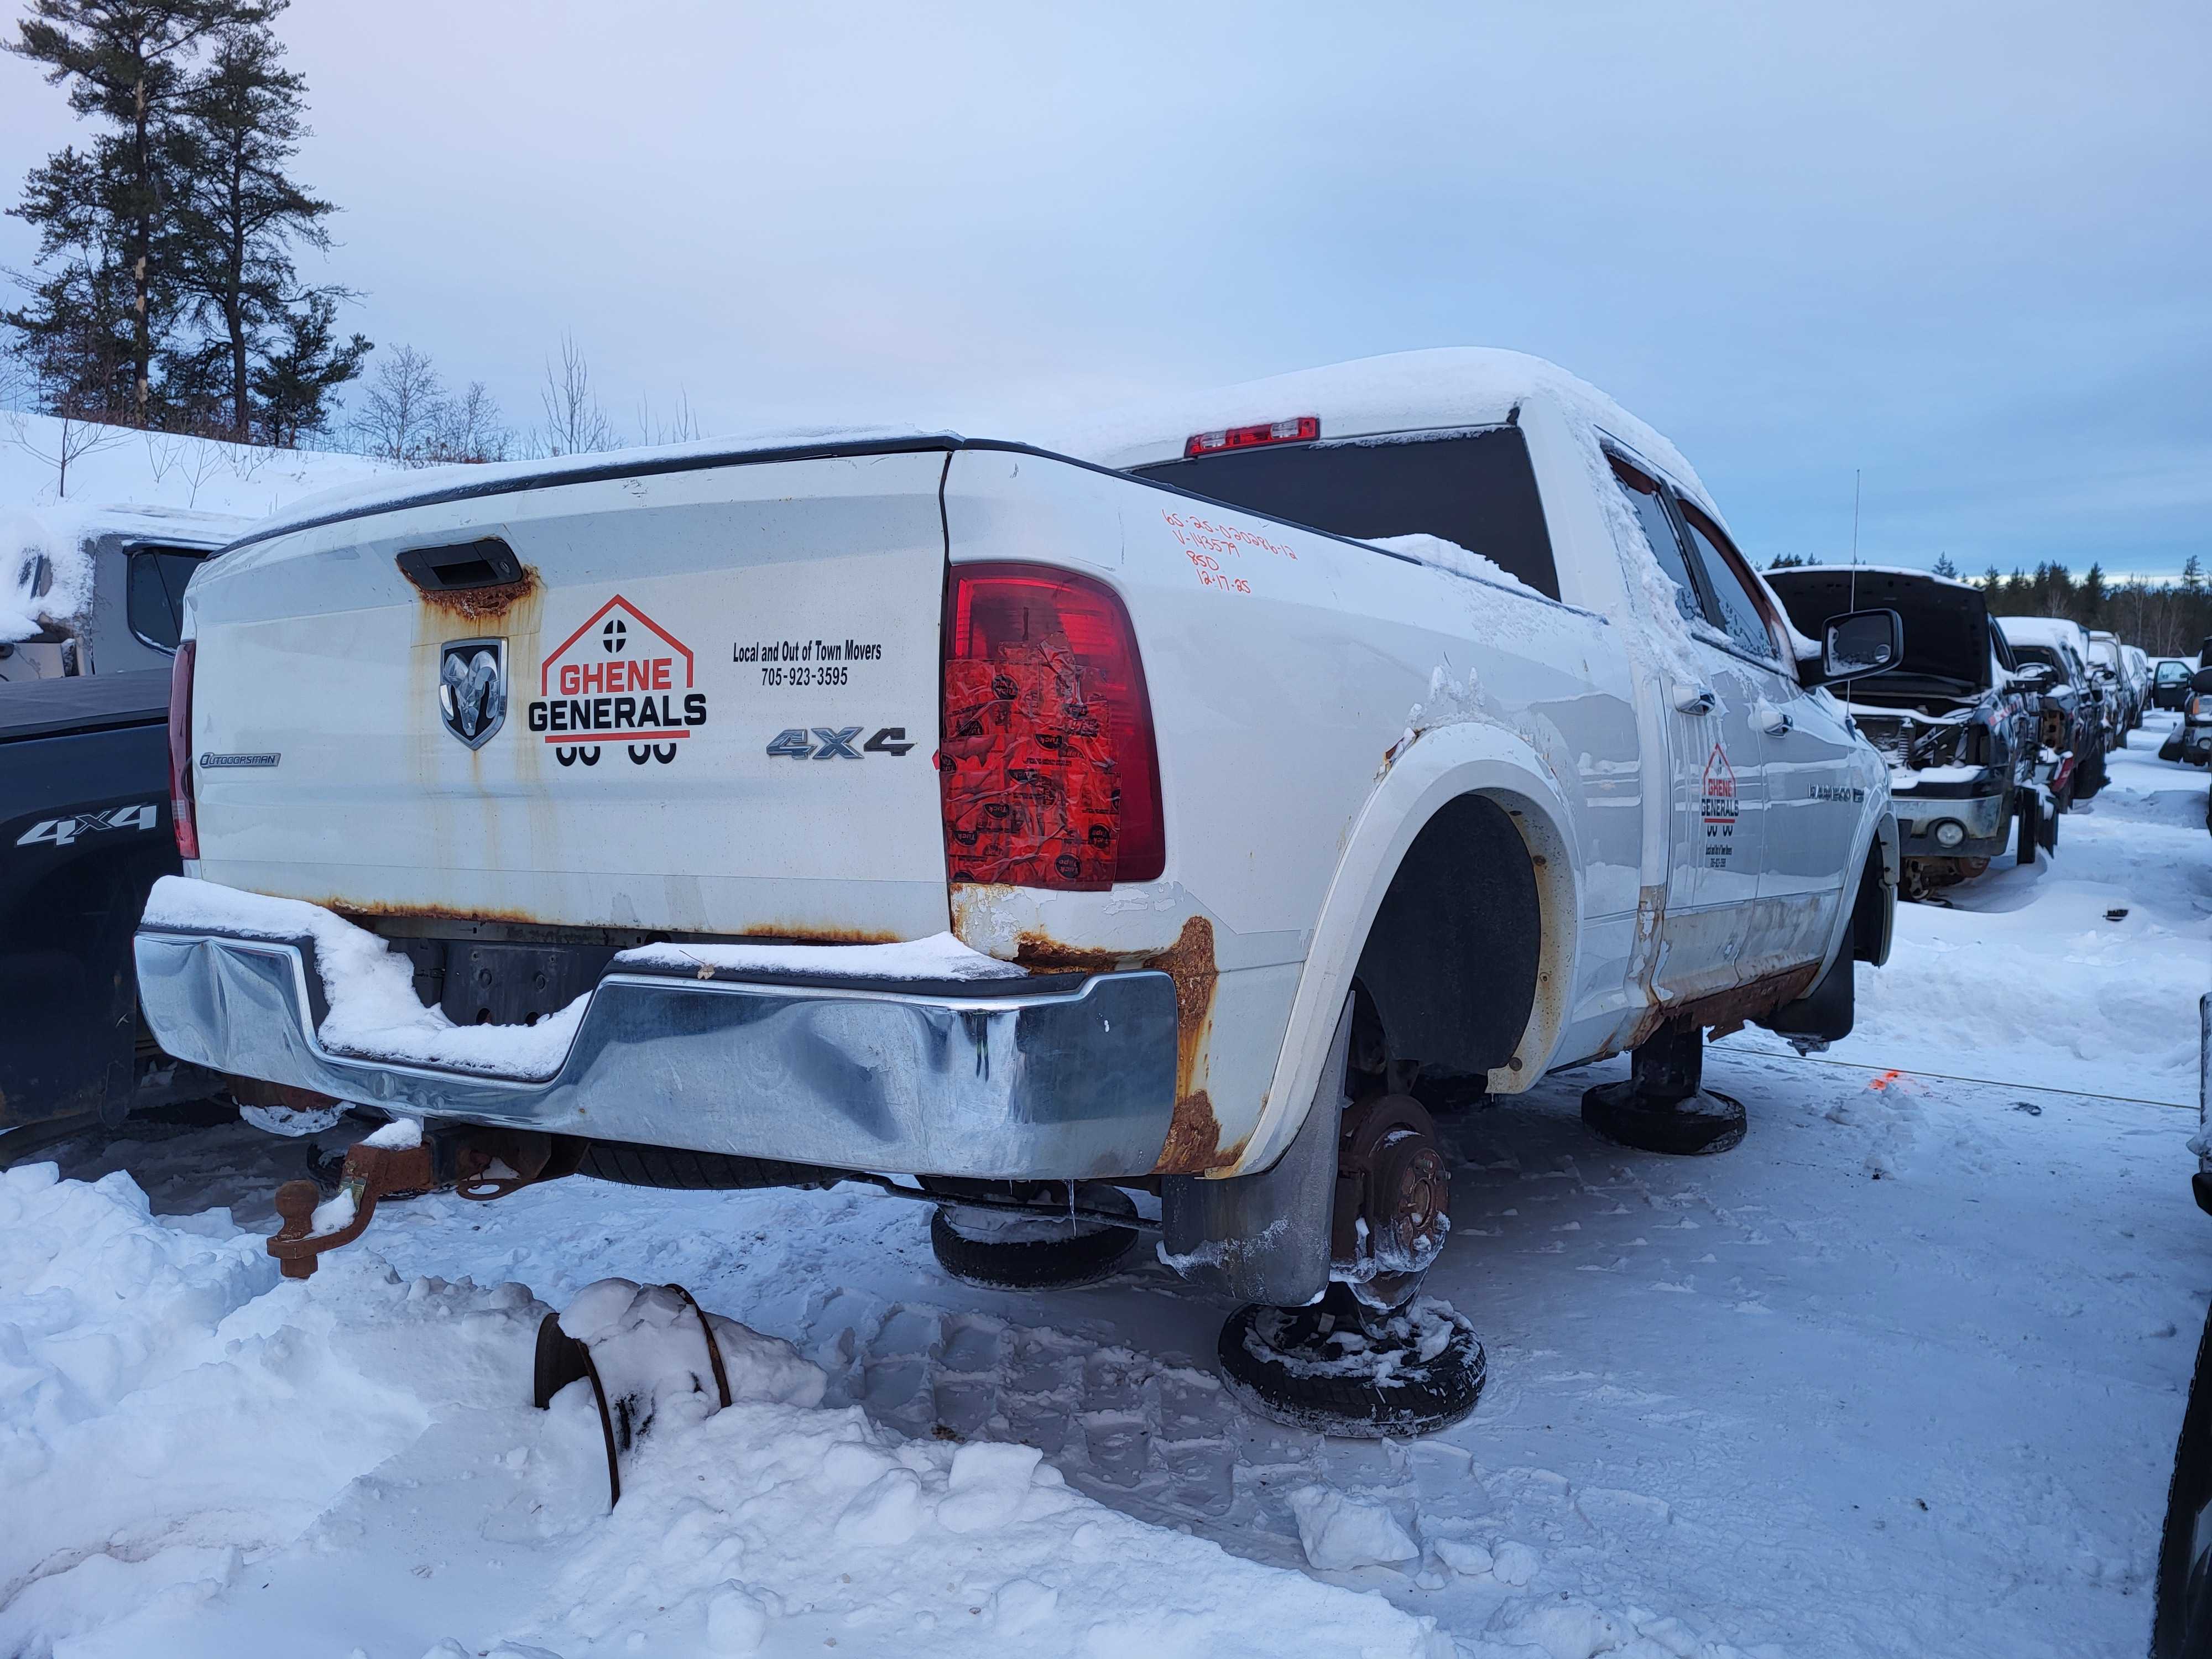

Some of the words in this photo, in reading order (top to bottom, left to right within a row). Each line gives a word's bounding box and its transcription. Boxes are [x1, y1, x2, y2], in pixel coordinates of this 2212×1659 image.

[733, 641, 759, 662] Local
[761, 641, 779, 662] and
[782, 640, 799, 661] Out
[802, 640, 812, 661] of
[815, 640, 841, 661] Town
[844, 639, 881, 660] Movers
[560, 658, 672, 696] GHENE
[761, 666, 848, 686] 705-923-3595
[529, 693, 707, 732] GENERALS
[766, 727, 917, 760] 4X4
[1708, 779, 1732, 797] GHENE
[1702, 799, 1739, 817] GENERALS
